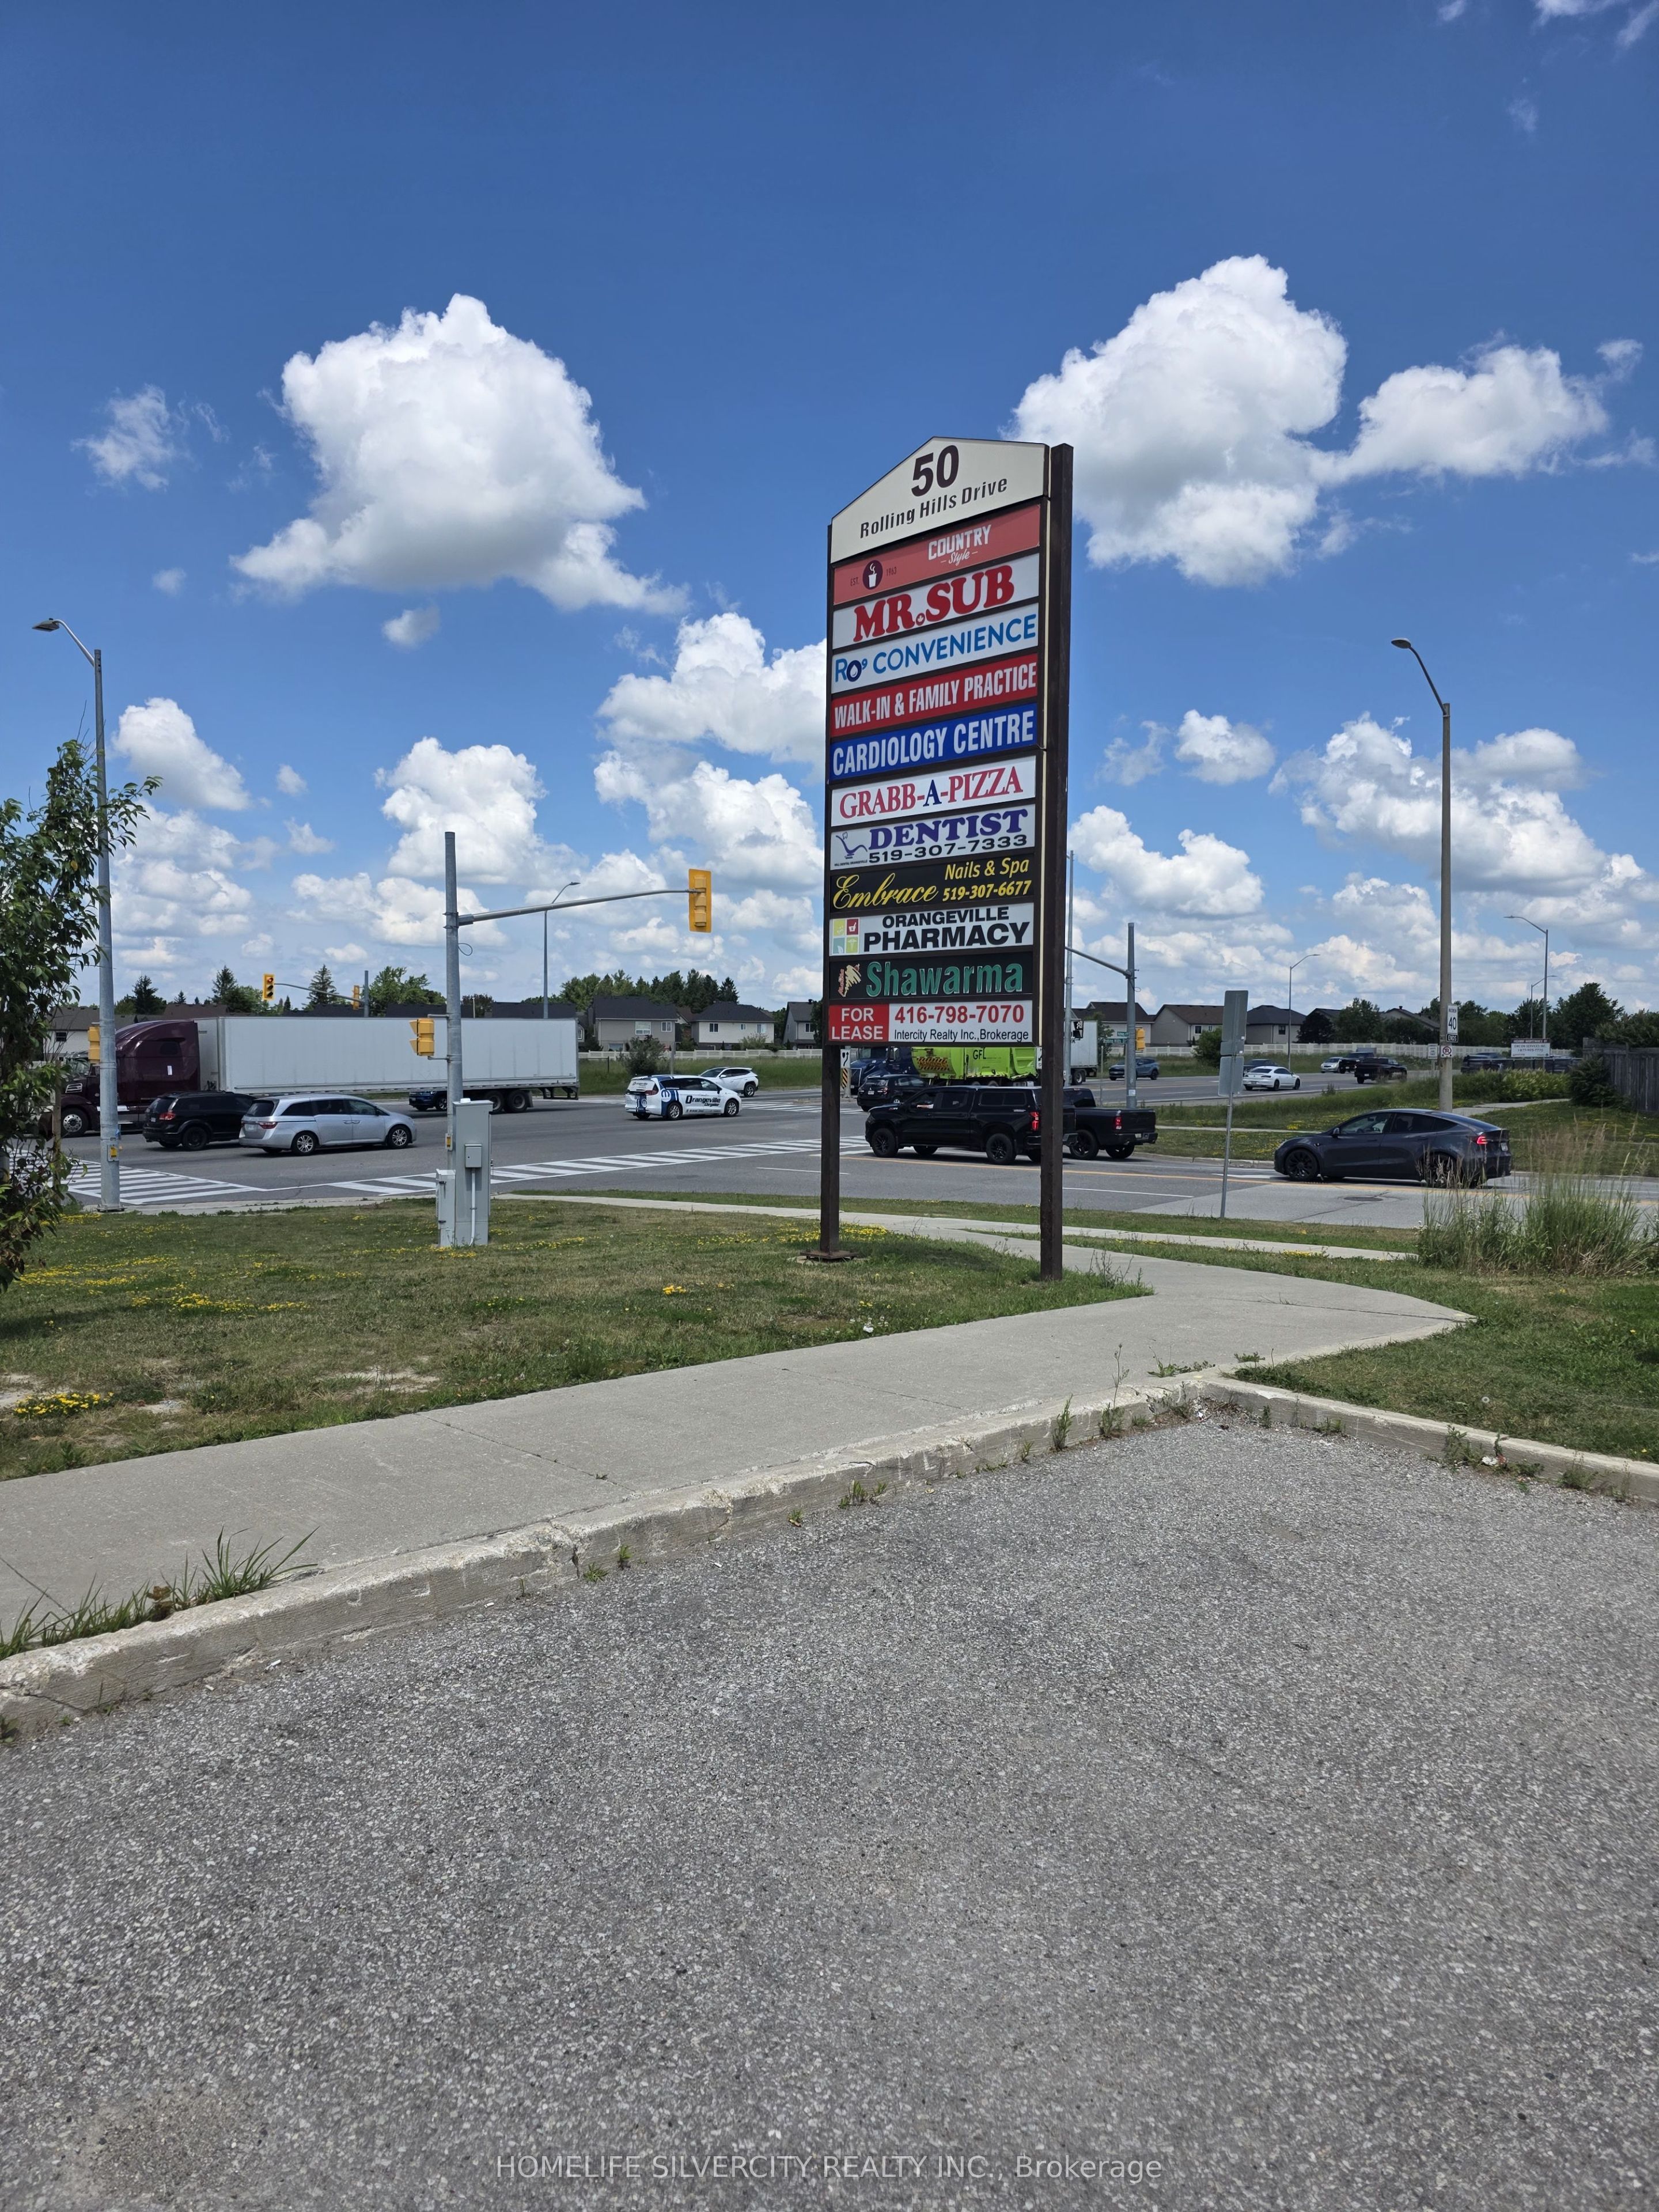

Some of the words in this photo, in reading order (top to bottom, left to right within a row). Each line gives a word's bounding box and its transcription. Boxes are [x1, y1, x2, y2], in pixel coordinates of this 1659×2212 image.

[911, 445, 959, 497] 50
[860, 508, 915, 539] Rolling
[920, 495, 956, 518] Hills
[961, 478, 1007, 505] Drive
[928, 525, 991, 560] COUNTRY
[948, 550, 970, 566] Style
[850, 577, 859, 586] EST.
[886, 566, 897, 576] 1963
[873, 614, 1036, 674] CONVENIENCE
[835, 695, 891, 729] WALK-IN
[895, 692, 904, 716] &
[909, 680, 960, 713] FAMILY
[964, 662, 1037, 702] PRACTICE
[833, 727, 948, 776] CARDIOLOGY
[953, 710, 1034, 755] CENTRE
[839, 766, 1024, 819] GRABB-A-PIZZA
[868, 808, 1028, 851] DENTIST
[869, 834, 1028, 863] 519-307-7333
[944, 862, 980, 880] Nails
[984, 860, 995, 876] &
[999, 857, 1029, 878] Spa
[833, 872, 938, 910] Embrace
[942, 880, 1032, 902] 519-307-6677
[882, 906, 1009, 929] ORANGEVILLE
[863, 922, 1030, 952] PHARMACY
[866, 961, 1023, 997] Shawarma
[841, 1007, 874, 1022] FOR
[895, 1004, 1024, 1024] 416-798-7070
[1448, 1017, 1457, 1030] 40
[831, 1026, 884, 1040] LEASE
[894, 1029, 927, 1043] Intercity
[930, 1029, 959, 1043] Realty
[973, 1049, 986, 1059] GFL
[685, 1095, 721, 1104] Orangeville
